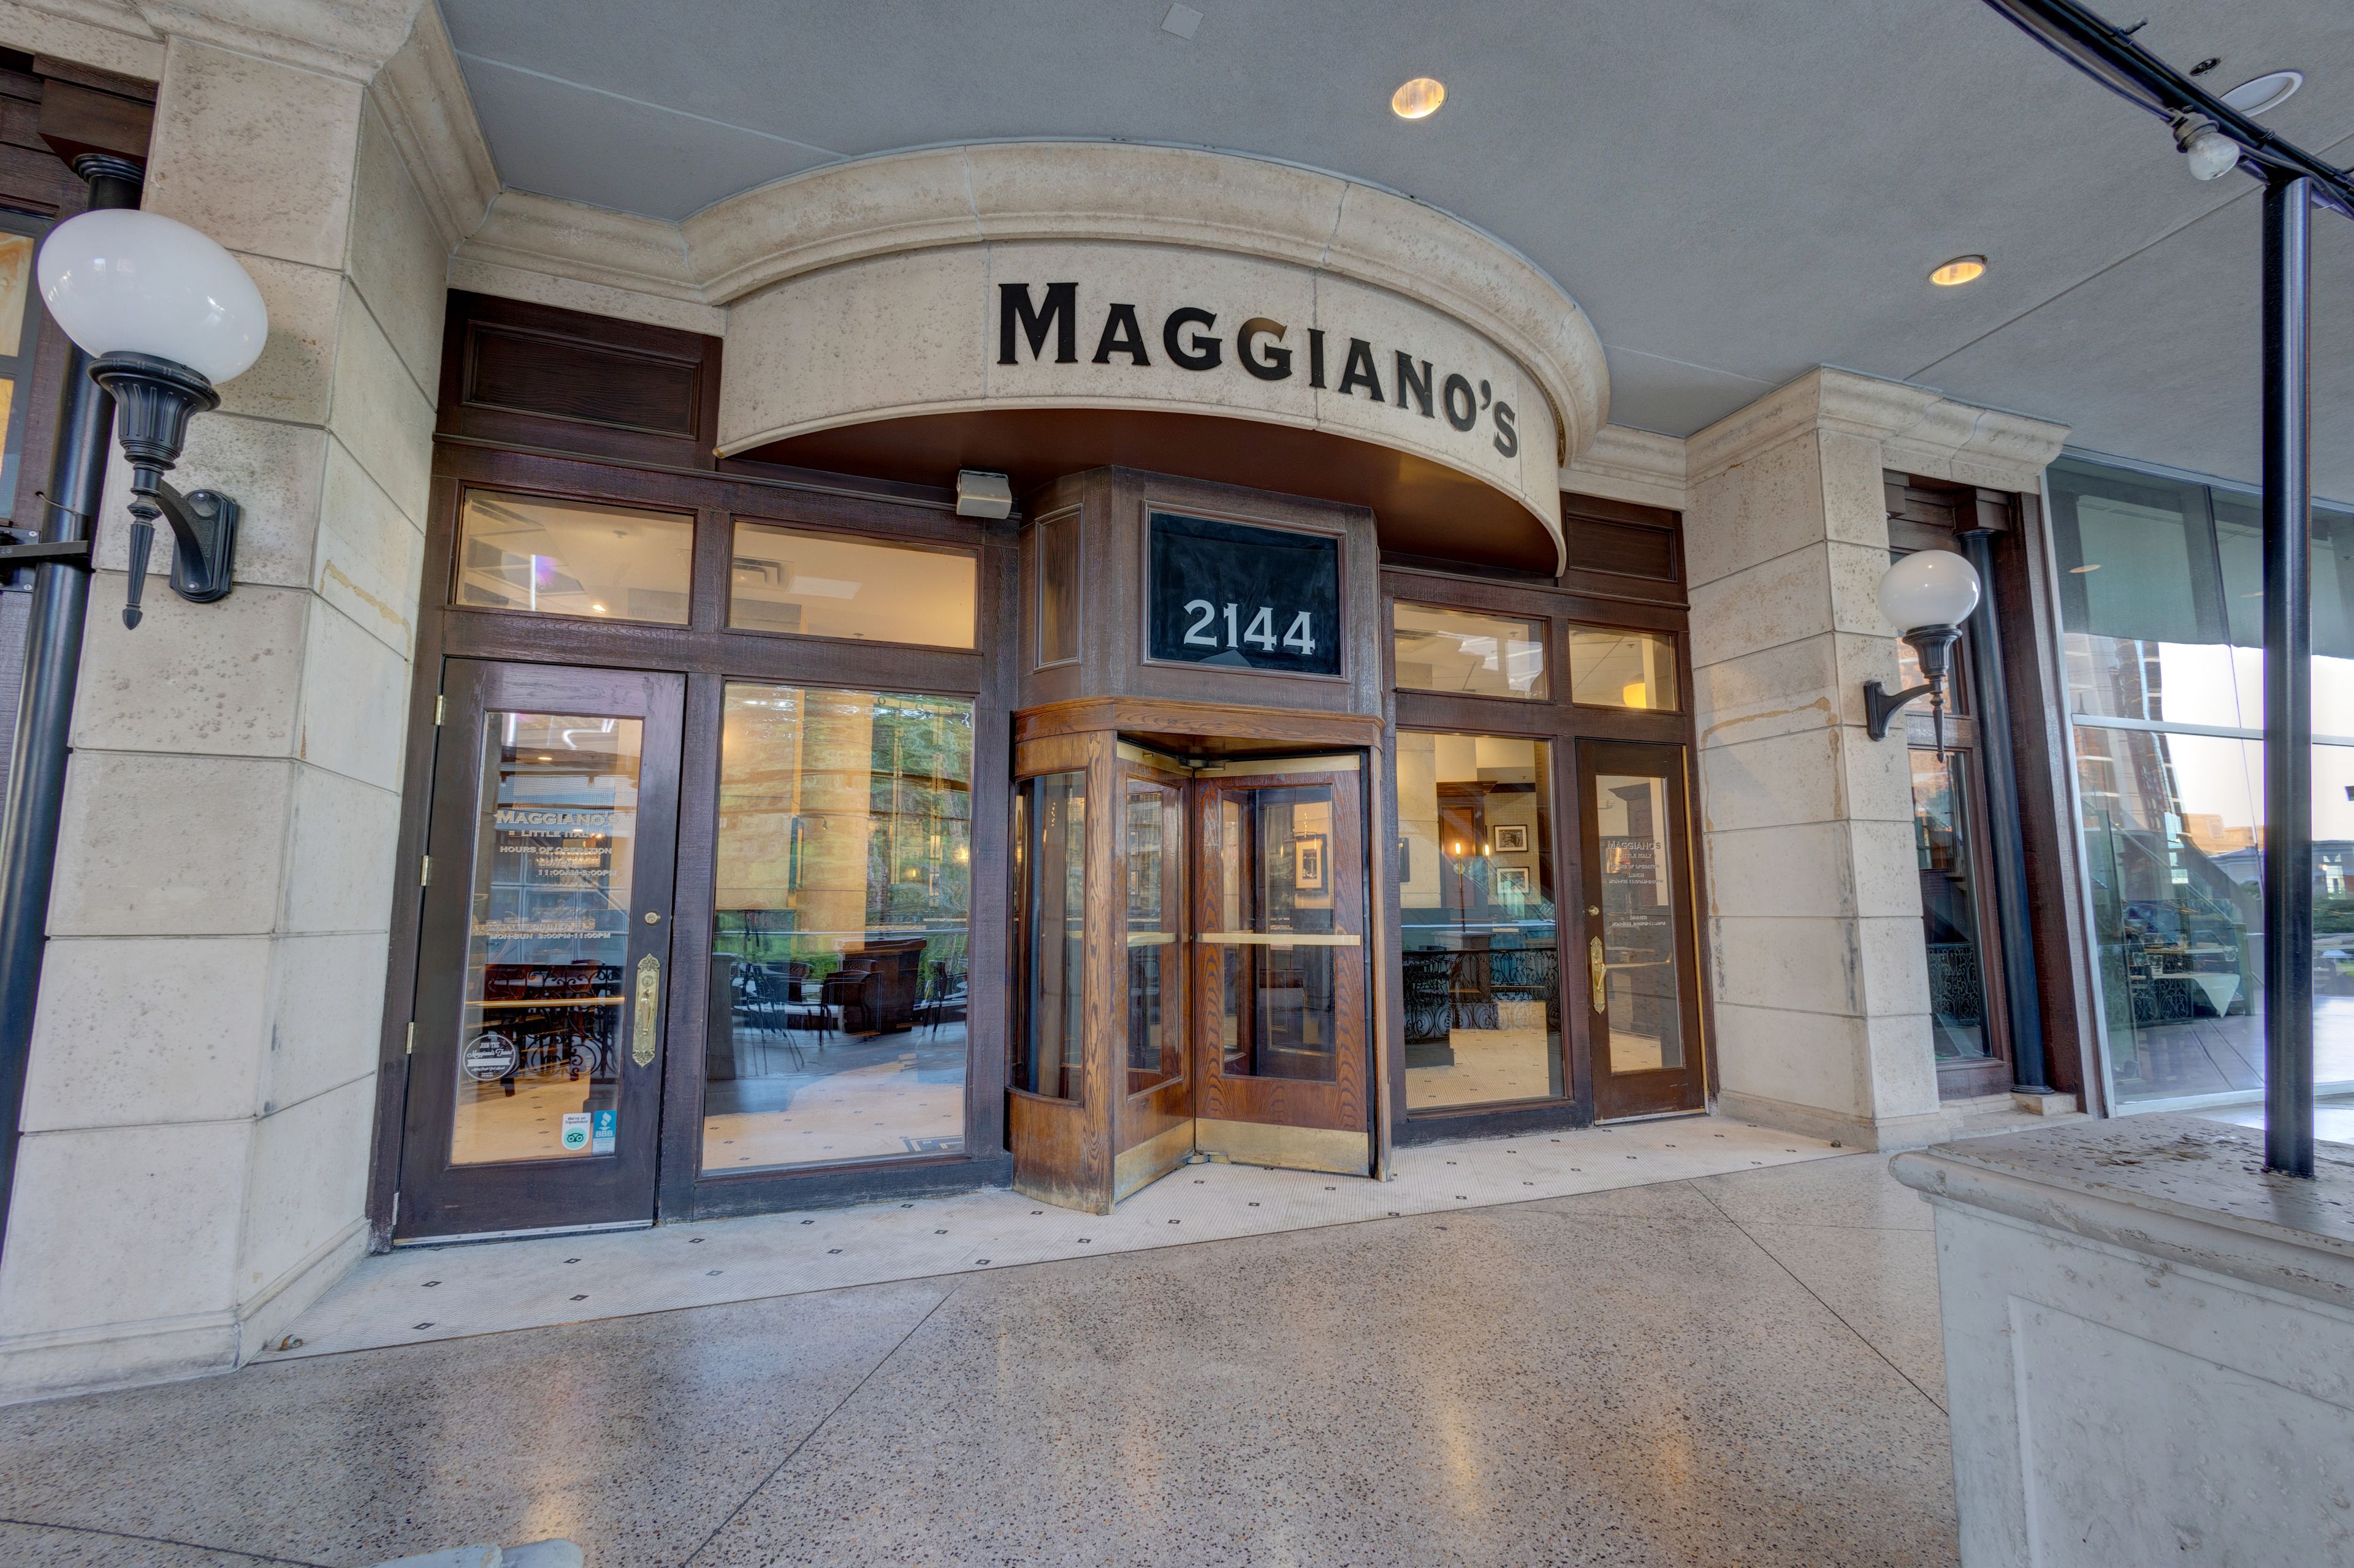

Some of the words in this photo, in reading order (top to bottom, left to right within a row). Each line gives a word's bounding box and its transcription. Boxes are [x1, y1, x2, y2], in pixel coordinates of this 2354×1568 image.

[997, 282, 1519, 459] MAGGIANO'S
[1183, 599, 1316, 655] 2144
[497, 810, 620, 826] MAGGIANO'S
[521, 829, 562, 838] LITTLE
